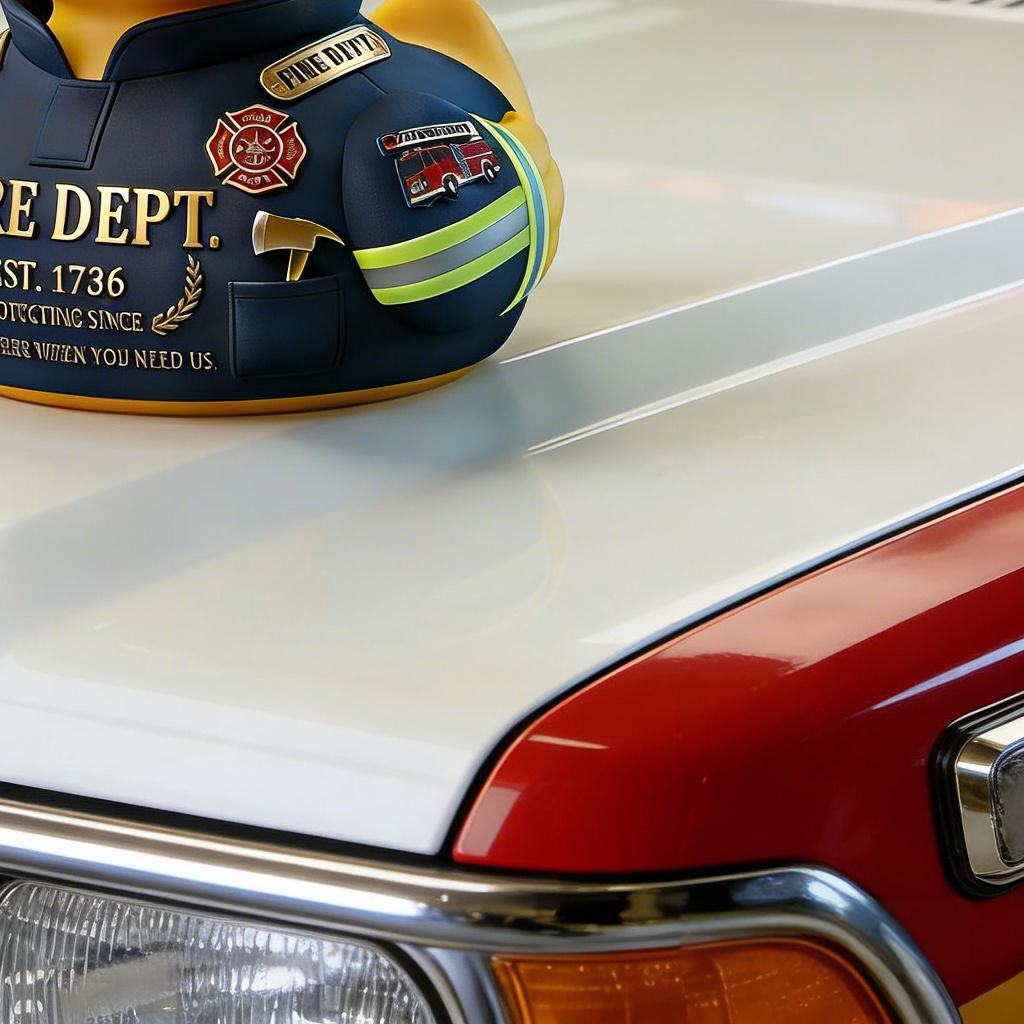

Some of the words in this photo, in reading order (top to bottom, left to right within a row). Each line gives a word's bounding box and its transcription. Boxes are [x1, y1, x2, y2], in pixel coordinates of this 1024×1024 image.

[51, 183, 220, 249] DEPT.
[52, 264, 125, 298] 1736
[87, 309, 144, 332] SINCE
[91, 349, 128, 366] YOU
[135, 350, 183, 370] NEED
